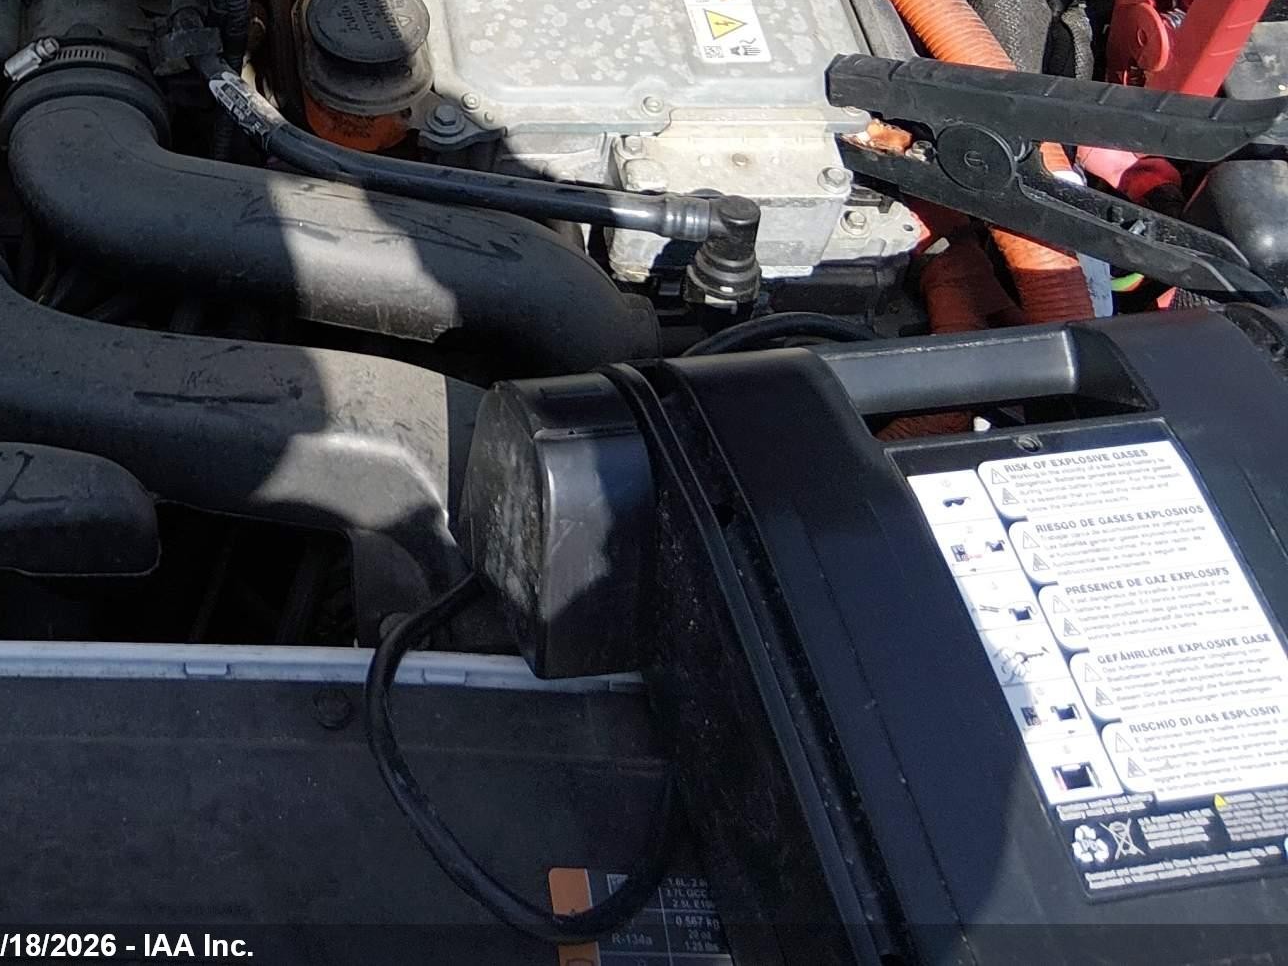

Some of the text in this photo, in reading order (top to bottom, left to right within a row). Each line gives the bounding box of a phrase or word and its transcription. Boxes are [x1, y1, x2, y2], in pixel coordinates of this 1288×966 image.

[1004, 449, 1149, 473] RISK OF EXPLOSIVE GASES
[1035, 505, 1204, 533] RIESGO DE GASES EXPLOSIVOS
[1126, 577, 1142, 587] DE
[1146, 574, 1167, 585] GAZ
[1170, 566, 1230, 582] EXPLOSIFS
[1177, 637, 1239, 654] EXPLOSIVE
[1242, 633, 1272, 644] GASE
[1128, 719, 1177, 734] RISCHIO
[1180, 717, 1193, 725] DI
[1195, 713, 1220, 724] GAS
[611, 933, 653, 945] R-134a
